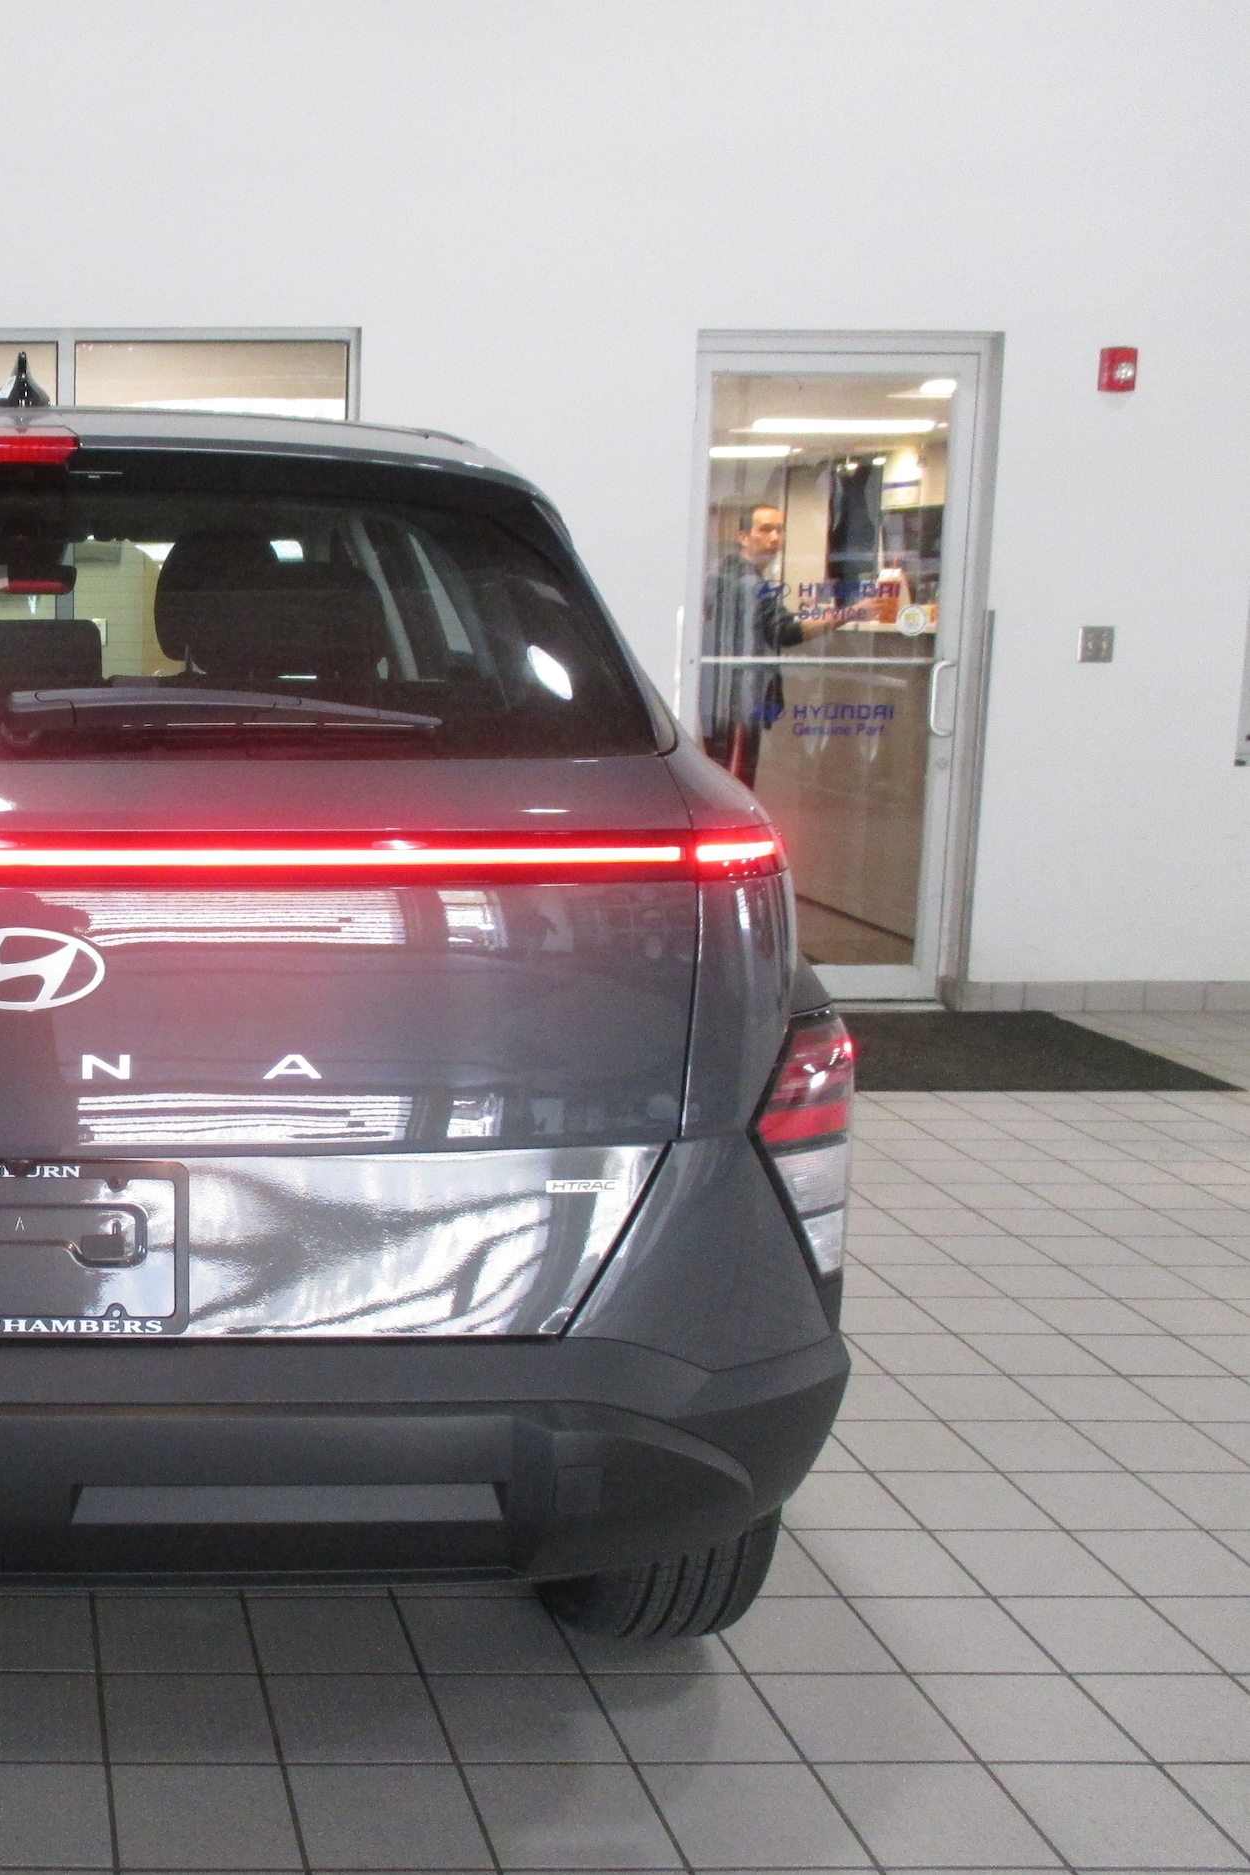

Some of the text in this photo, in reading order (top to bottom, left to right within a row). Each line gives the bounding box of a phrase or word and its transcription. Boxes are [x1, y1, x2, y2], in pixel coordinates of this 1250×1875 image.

[798, 582, 900, 598] HYDAI
[798, 602, 866, 620] Service
[793, 704, 895, 720] HYUNDAI
[552, 1181, 617, 1191] HTRAC
